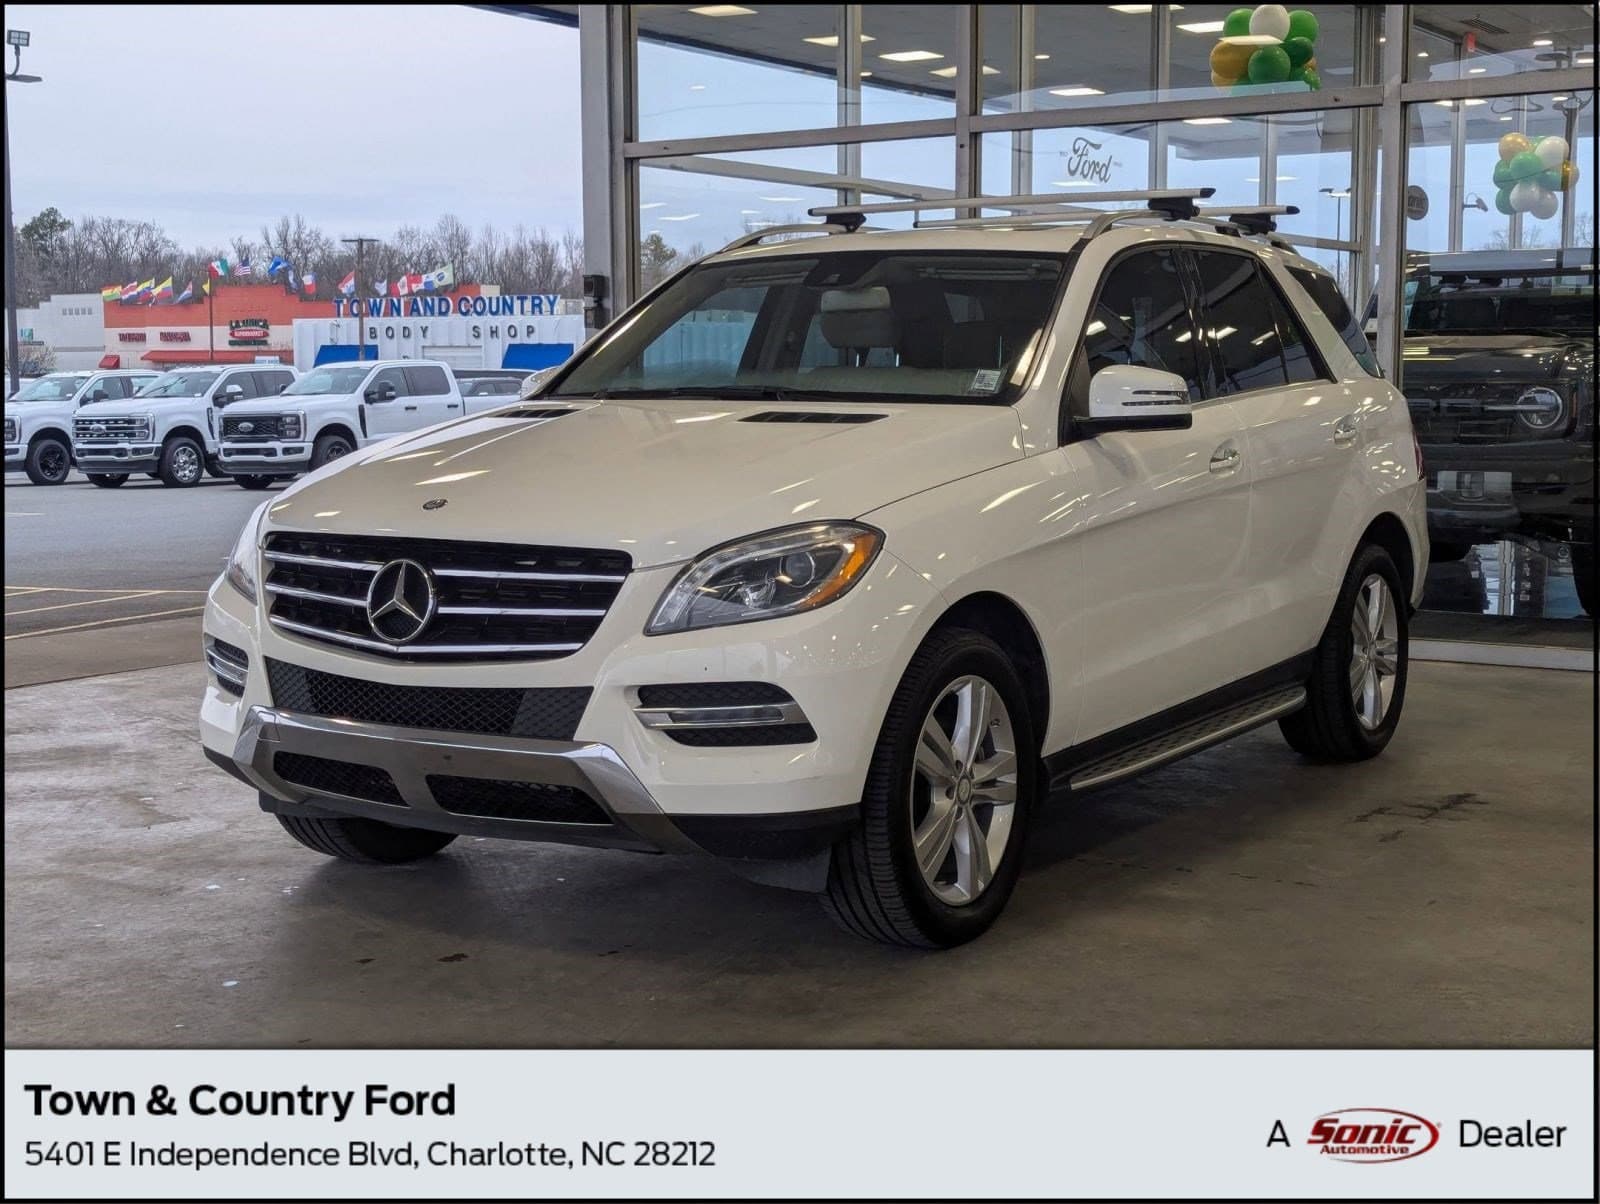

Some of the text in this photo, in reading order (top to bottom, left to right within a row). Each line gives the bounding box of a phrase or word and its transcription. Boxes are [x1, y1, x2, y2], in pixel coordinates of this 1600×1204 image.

[1068, 137, 1112, 183] Ford
[335, 295, 560, 317] TOWN AND COUNTRY
[369, 325, 535, 339] BODY SHOP
